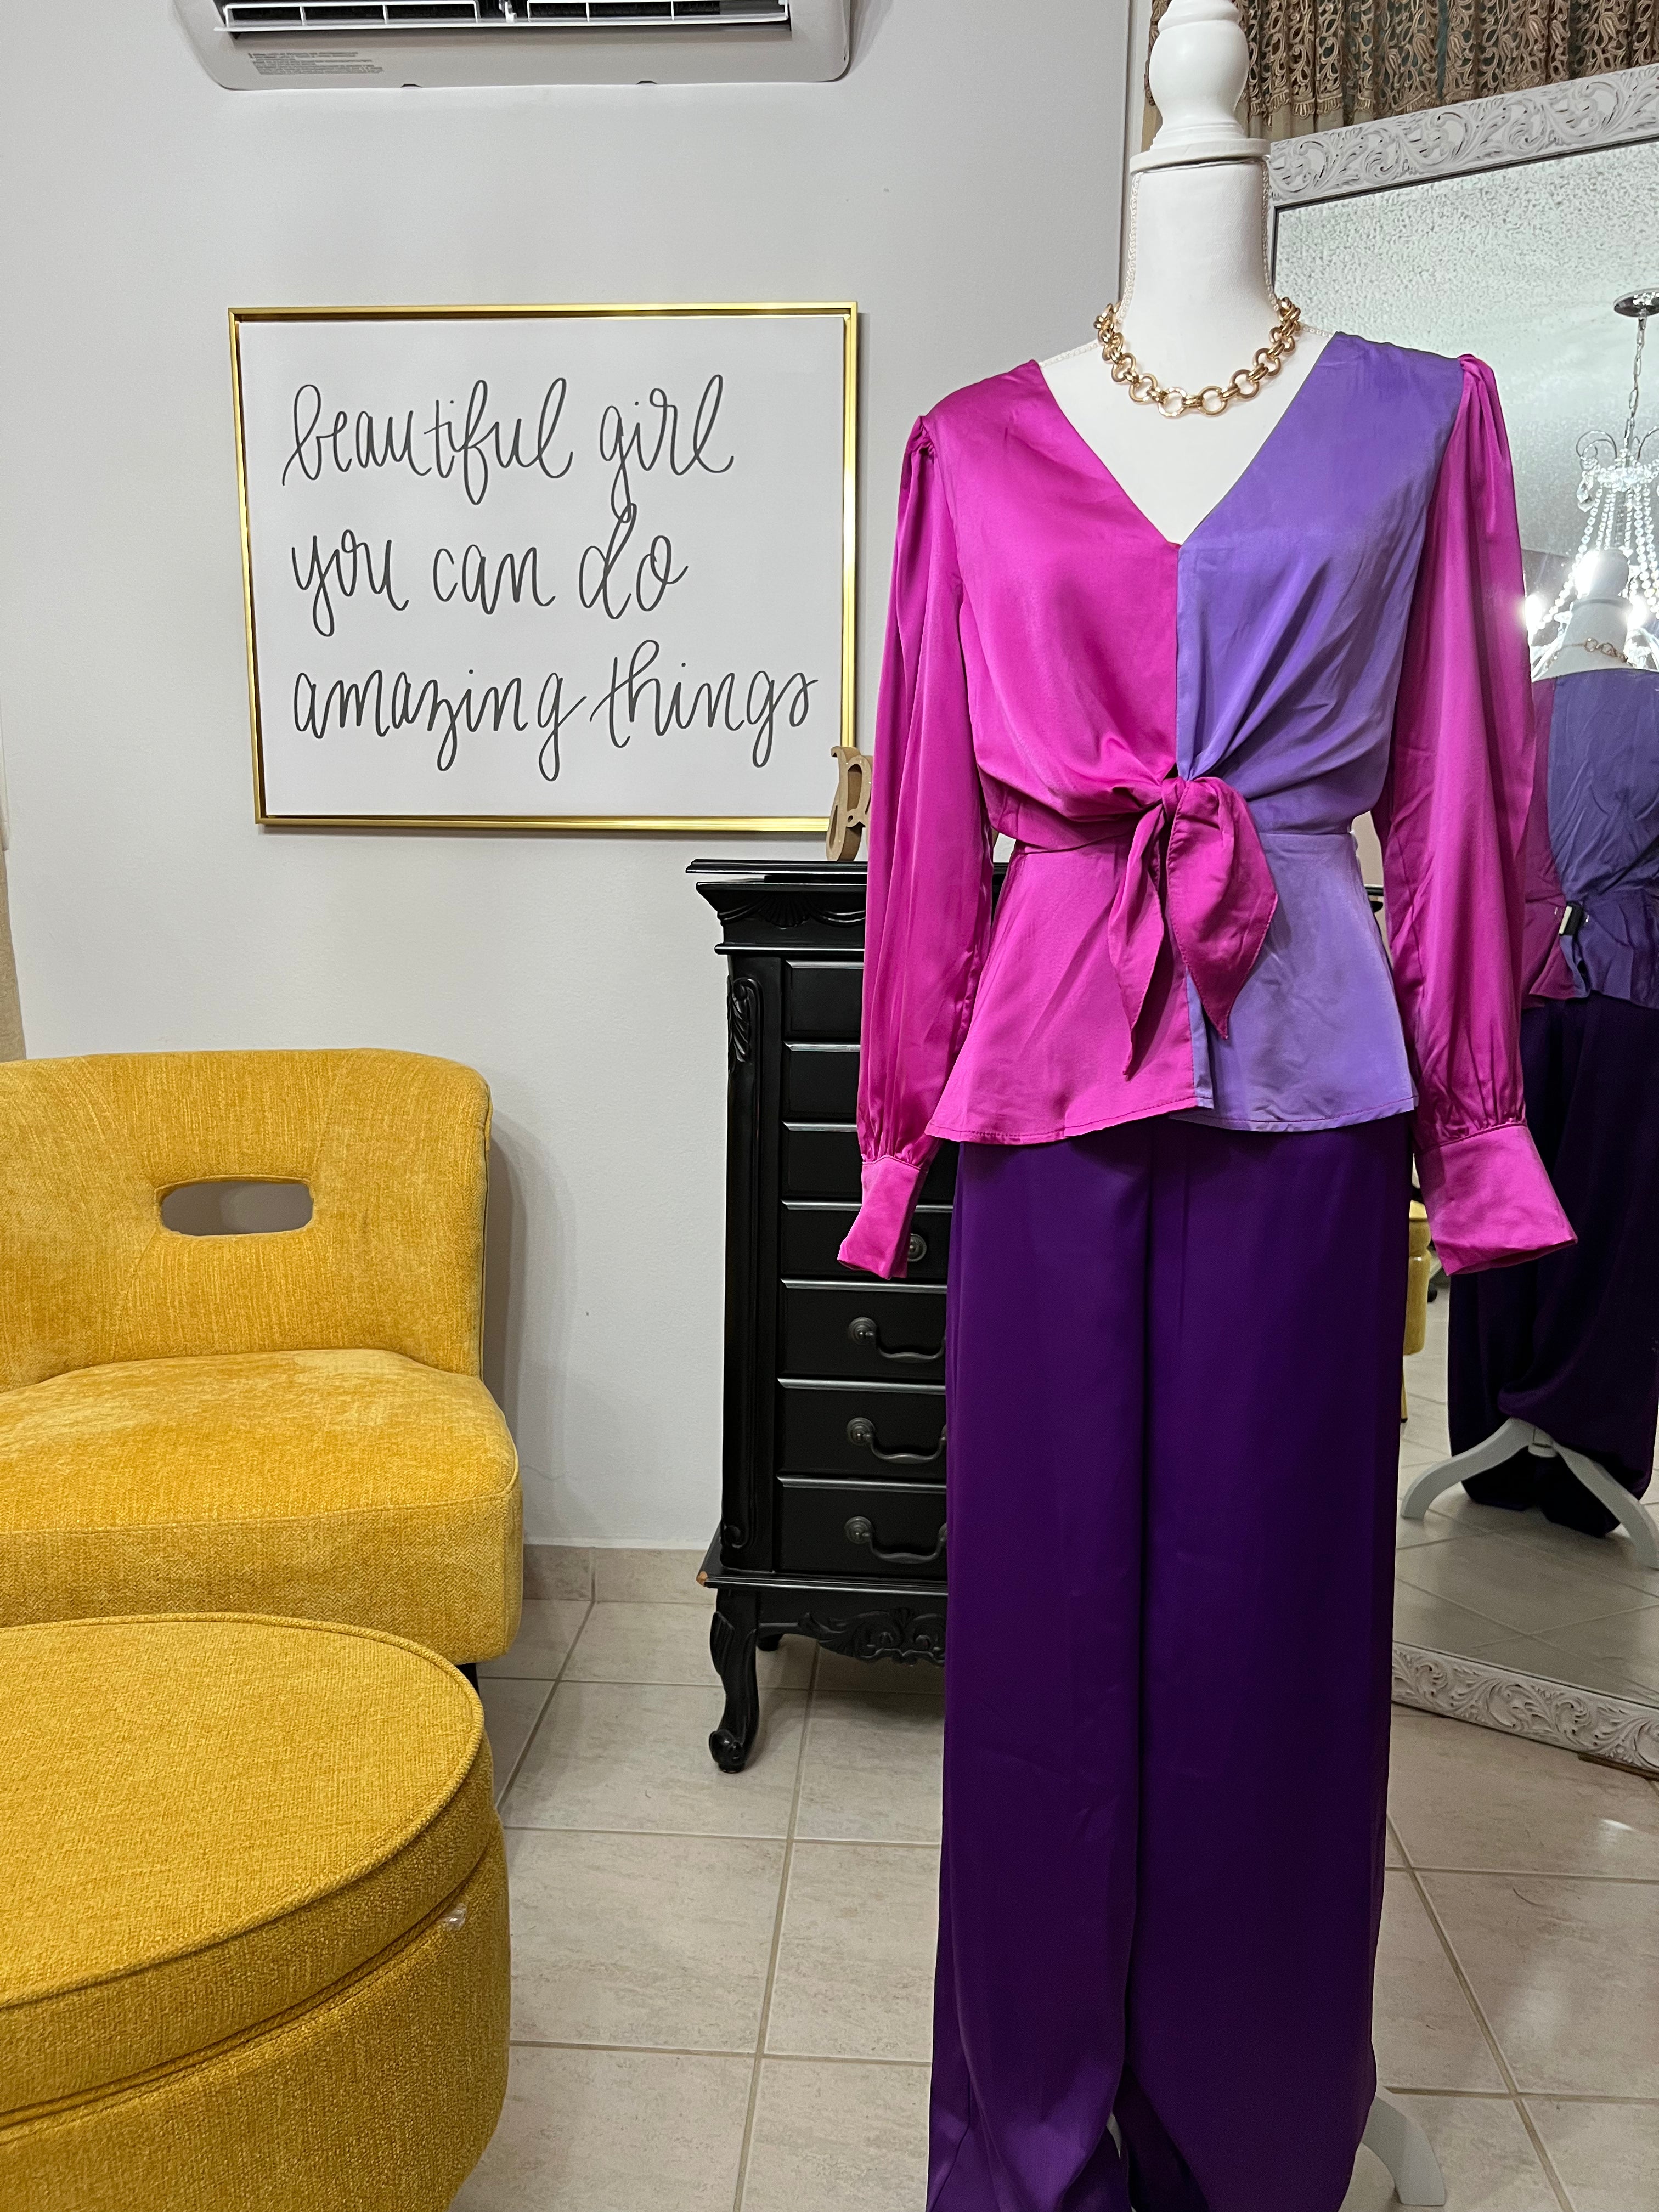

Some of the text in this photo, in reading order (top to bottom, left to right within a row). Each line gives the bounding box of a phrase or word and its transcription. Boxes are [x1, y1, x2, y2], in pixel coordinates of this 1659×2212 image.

[281, 374, 735, 523] beautiful girl
[291, 503, 689, 637] you can do
[293, 639, 819, 782] amazing things
